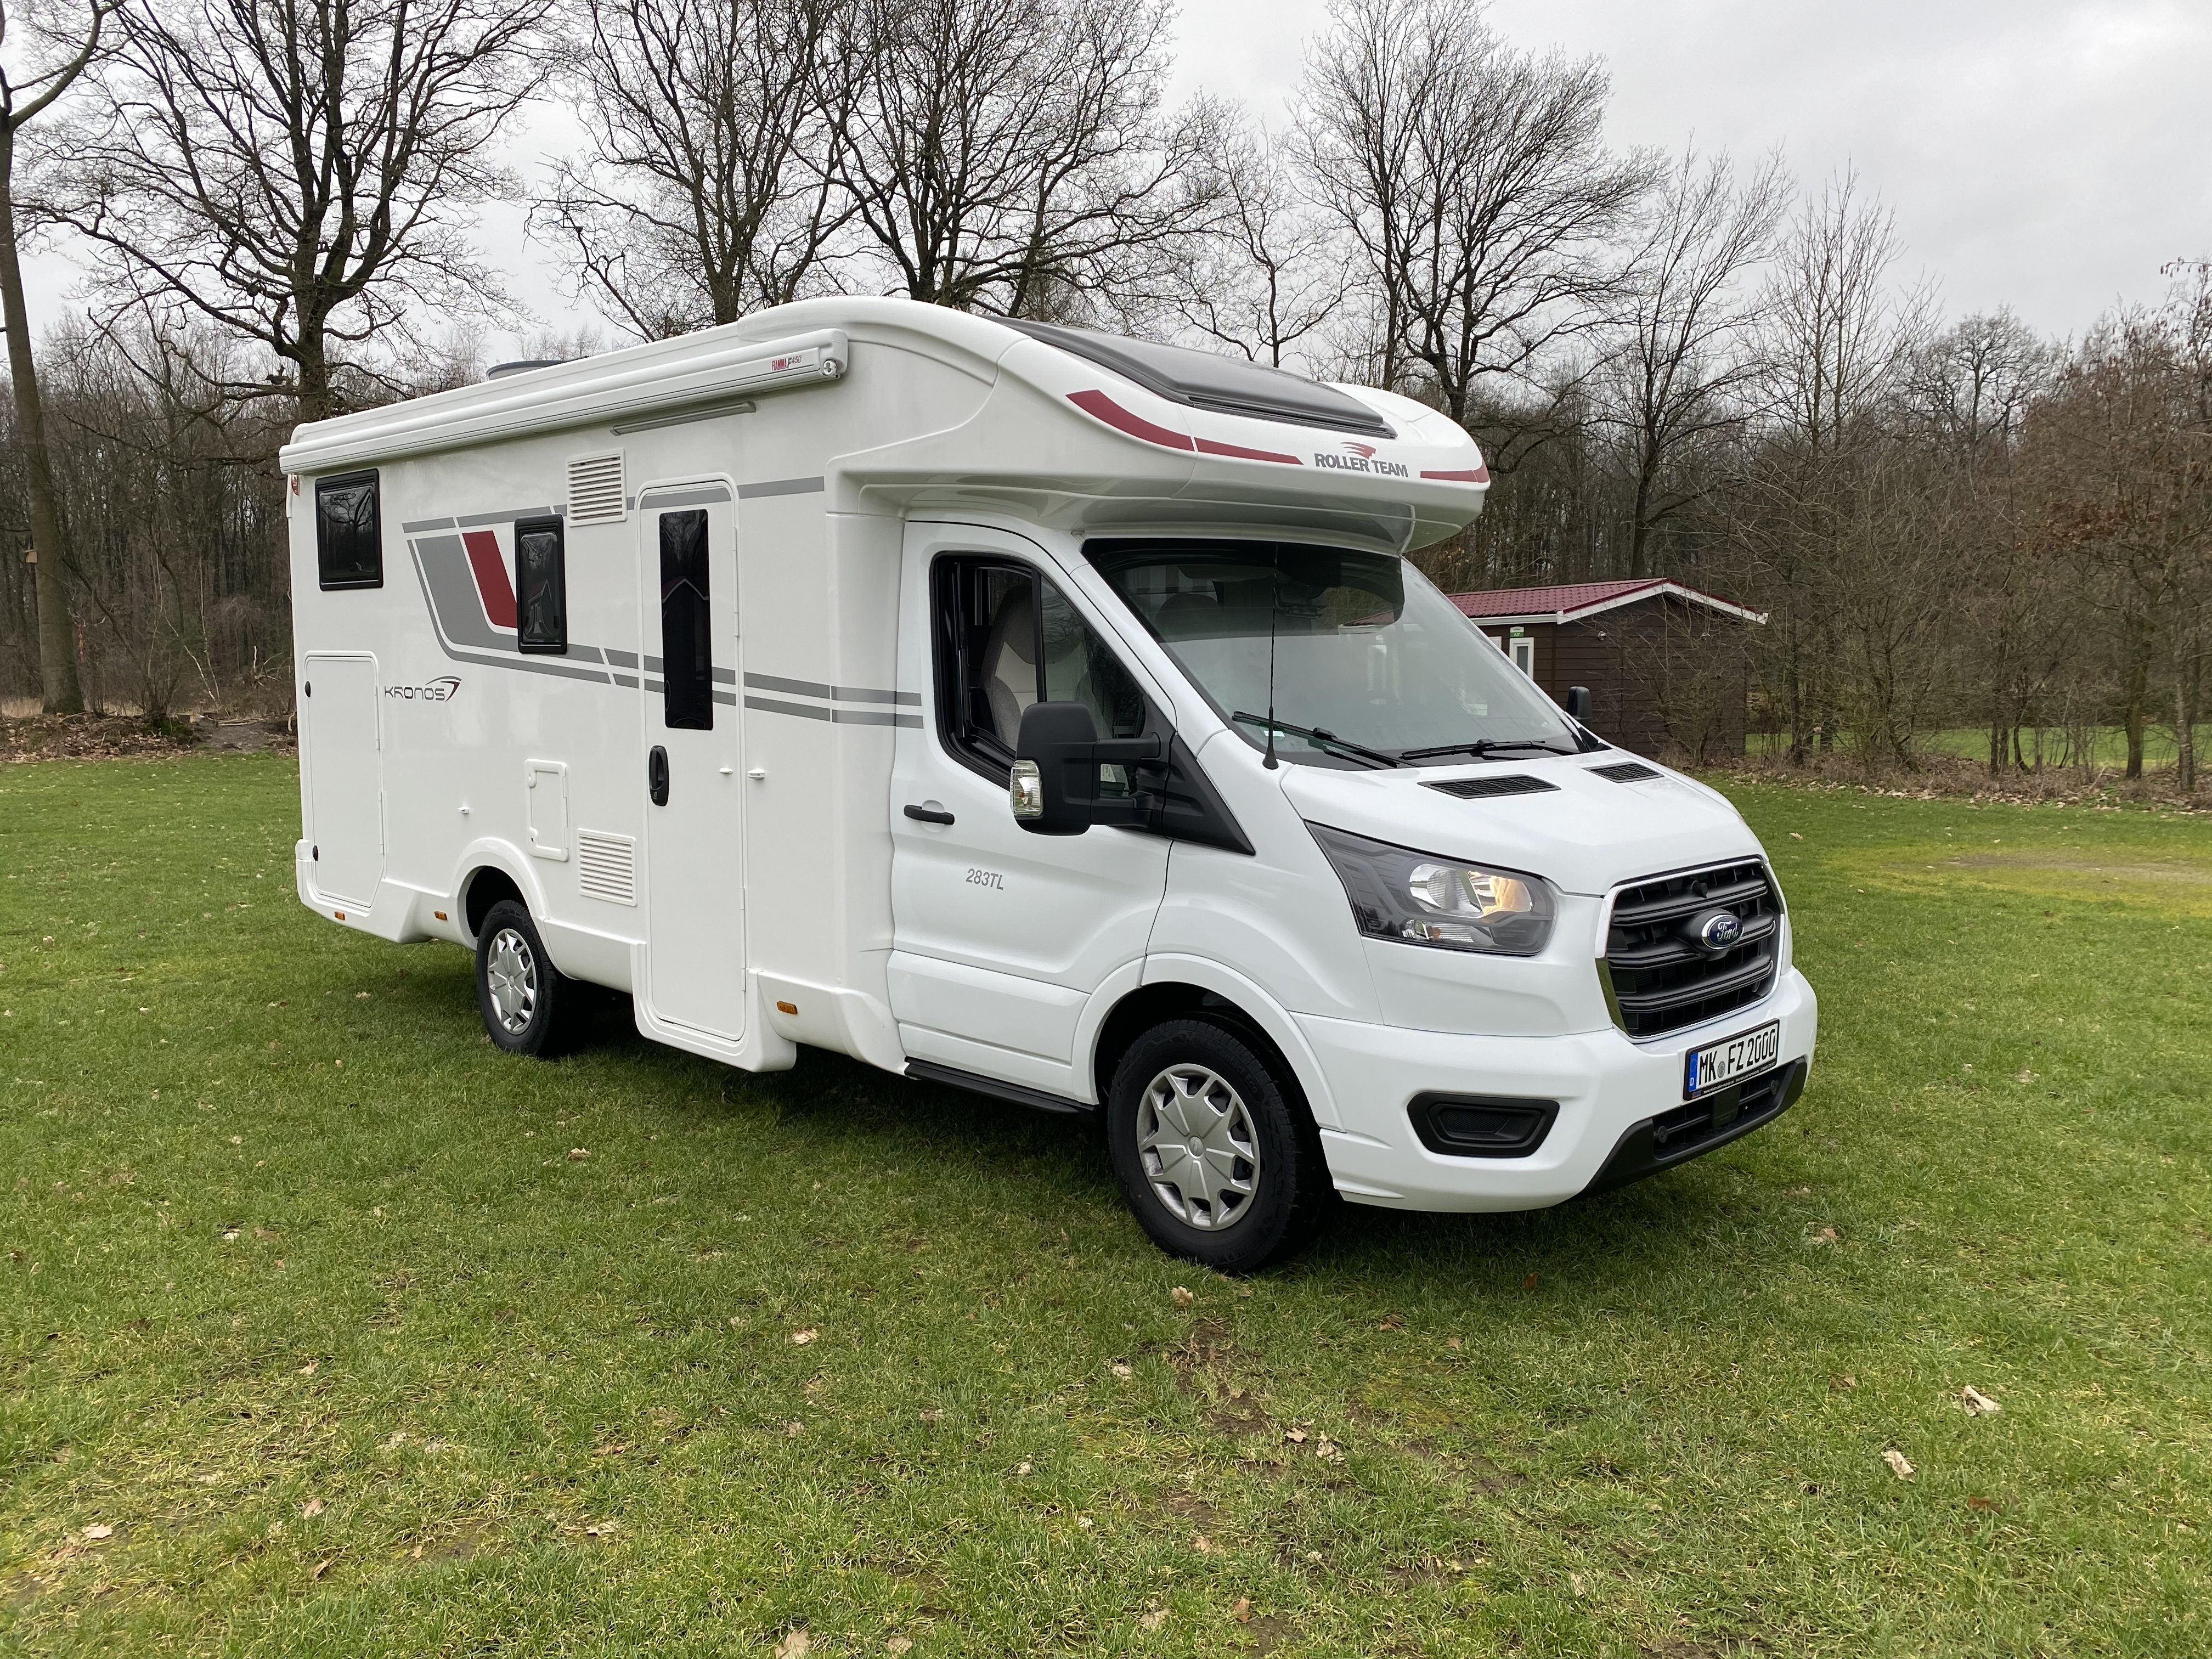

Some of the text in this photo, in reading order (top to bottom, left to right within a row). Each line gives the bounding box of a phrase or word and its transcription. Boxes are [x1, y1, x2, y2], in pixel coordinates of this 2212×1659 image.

[1314, 453, 1409, 478] ROLLER TEAM
[384, 685, 445, 701] KRONOS
[966, 868, 1004, 890] 283TL
[1717, 920, 1739, 942] Ford
[1699, 1028, 1776, 1086] MK FZ 2000
[1690, 1077, 1695, 1086] D
